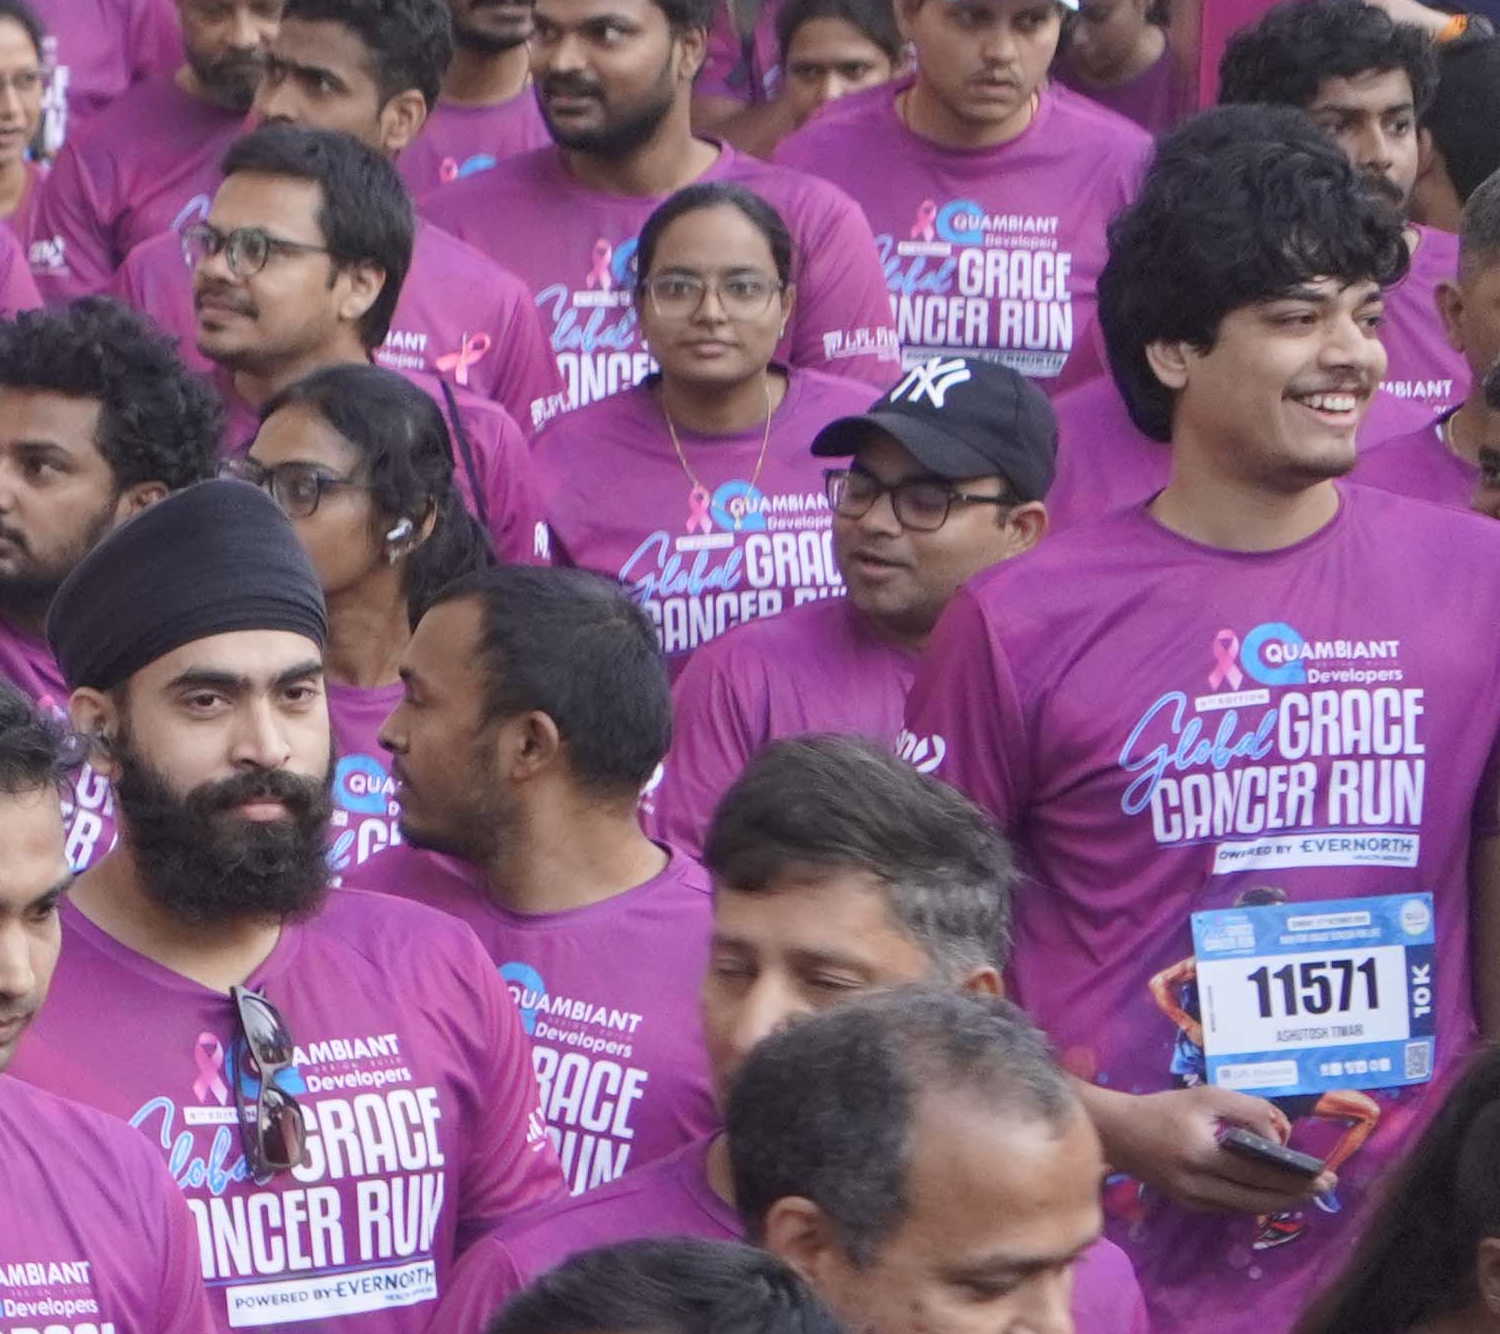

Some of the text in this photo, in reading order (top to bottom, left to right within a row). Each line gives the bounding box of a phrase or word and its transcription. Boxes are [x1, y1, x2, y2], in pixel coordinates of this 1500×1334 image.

[952, 211, 1059, 234] QUAMBIANT
[959, 250, 1072, 303] GRACE
[999, 299, 1074, 351] RUN
[729, 492, 830, 517] QUAMBIAN
[619, 531, 842, 609] Global GRAC
[1264, 639, 1400, 663] QUAMBIANT
[1307, 666, 1403, 685] Developers
[1119, 688, 1425, 815] Global GRACE
[1151, 759, 1425, 844] CANCER RUN
[1276, 837, 1414, 855] BY EVERNORTH
[1247, 957, 1380, 1018] 11571
[1411, 963, 1432, 1018] 10K
[506, 985, 644, 1035] QUAMBIANT
[293, 1033, 399, 1069] AMBIANT
[534, 1021, 634, 1060] Developers
[306, 1066, 412, 1093] Developers
[356, 1171, 445, 1259] RUN
[3, 1294, 99, 1319] Developers
[235, 1268, 436, 1310] POWERED BY EVERNORTH
